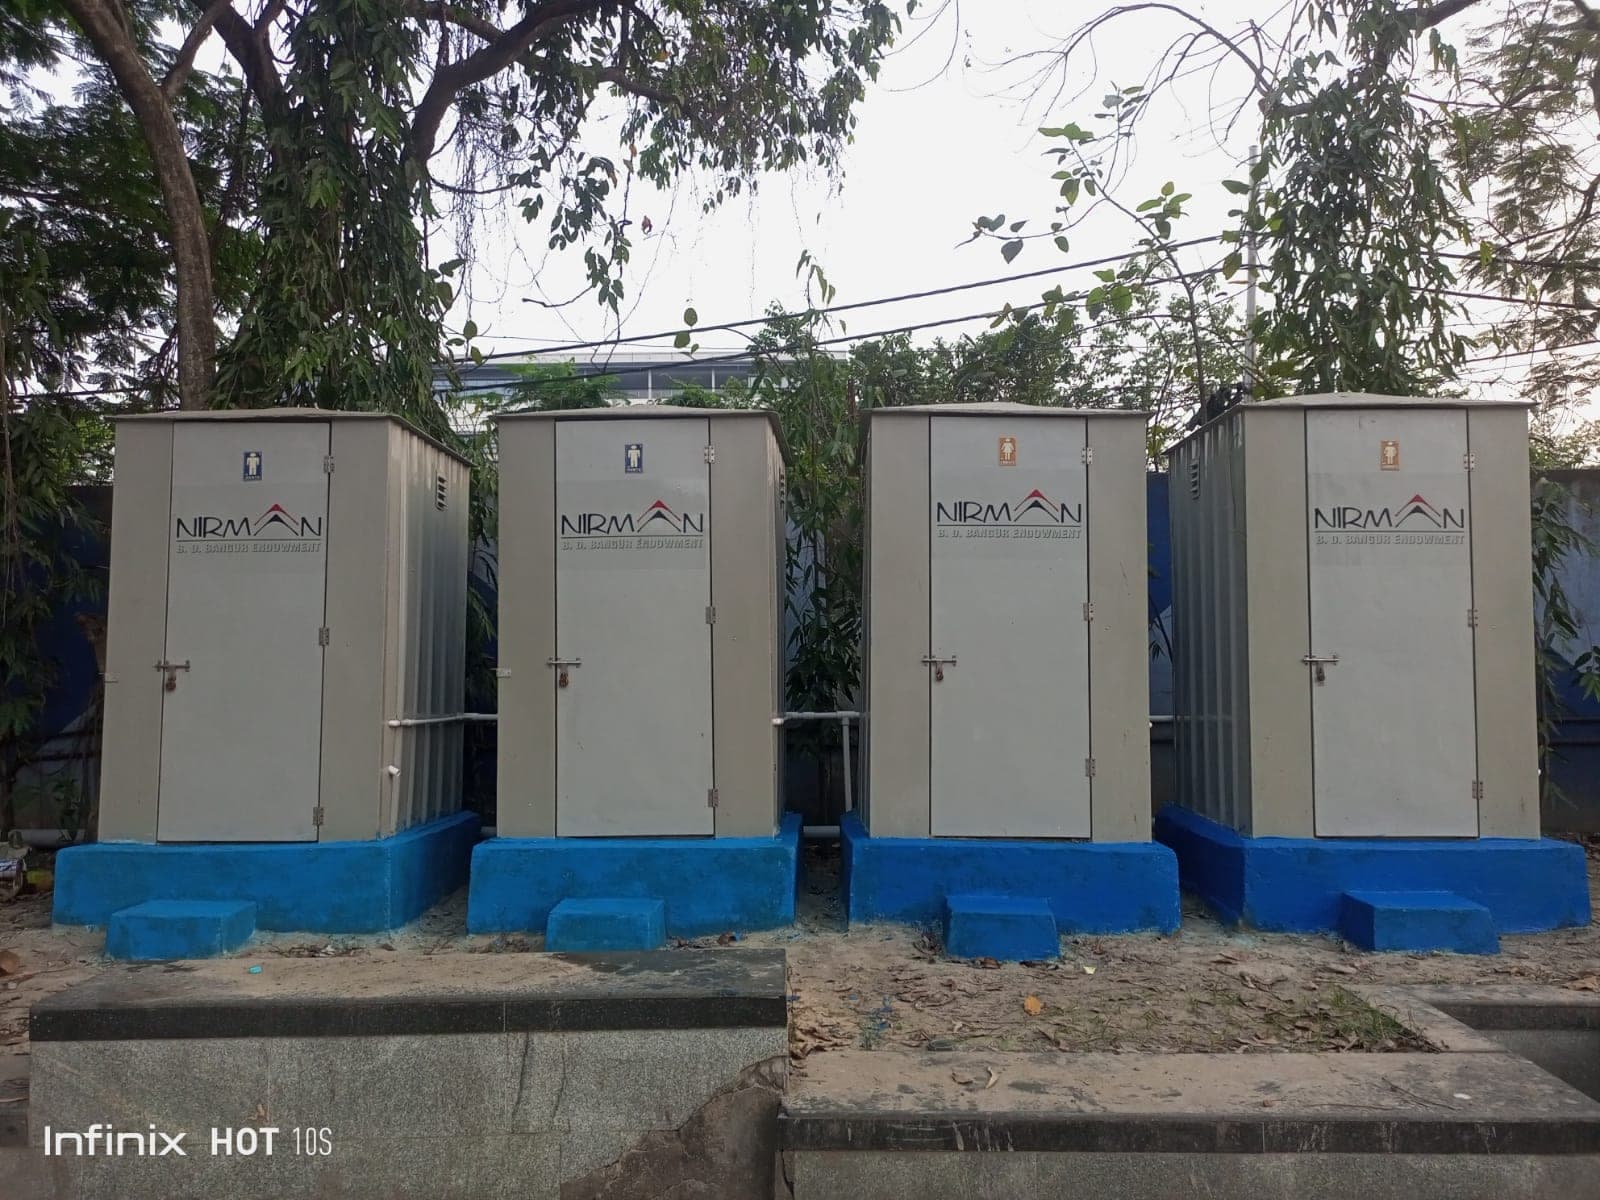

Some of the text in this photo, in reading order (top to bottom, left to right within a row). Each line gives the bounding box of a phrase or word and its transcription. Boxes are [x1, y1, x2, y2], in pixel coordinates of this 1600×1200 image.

[937, 489, 1081, 523] NIRMAN
[1315, 494, 1464, 529] NIRMAN
[177, 504, 321, 538] NIRMAN
[561, 500, 703, 535] NIRMAN
[636, 539, 703, 549] ENDOWMENT
[1013, 529, 1081, 539] ENDOWMENT
[1394, 535, 1464, 545] ENDOWMENT
[252, 543, 321, 552] ENDOWMENT
